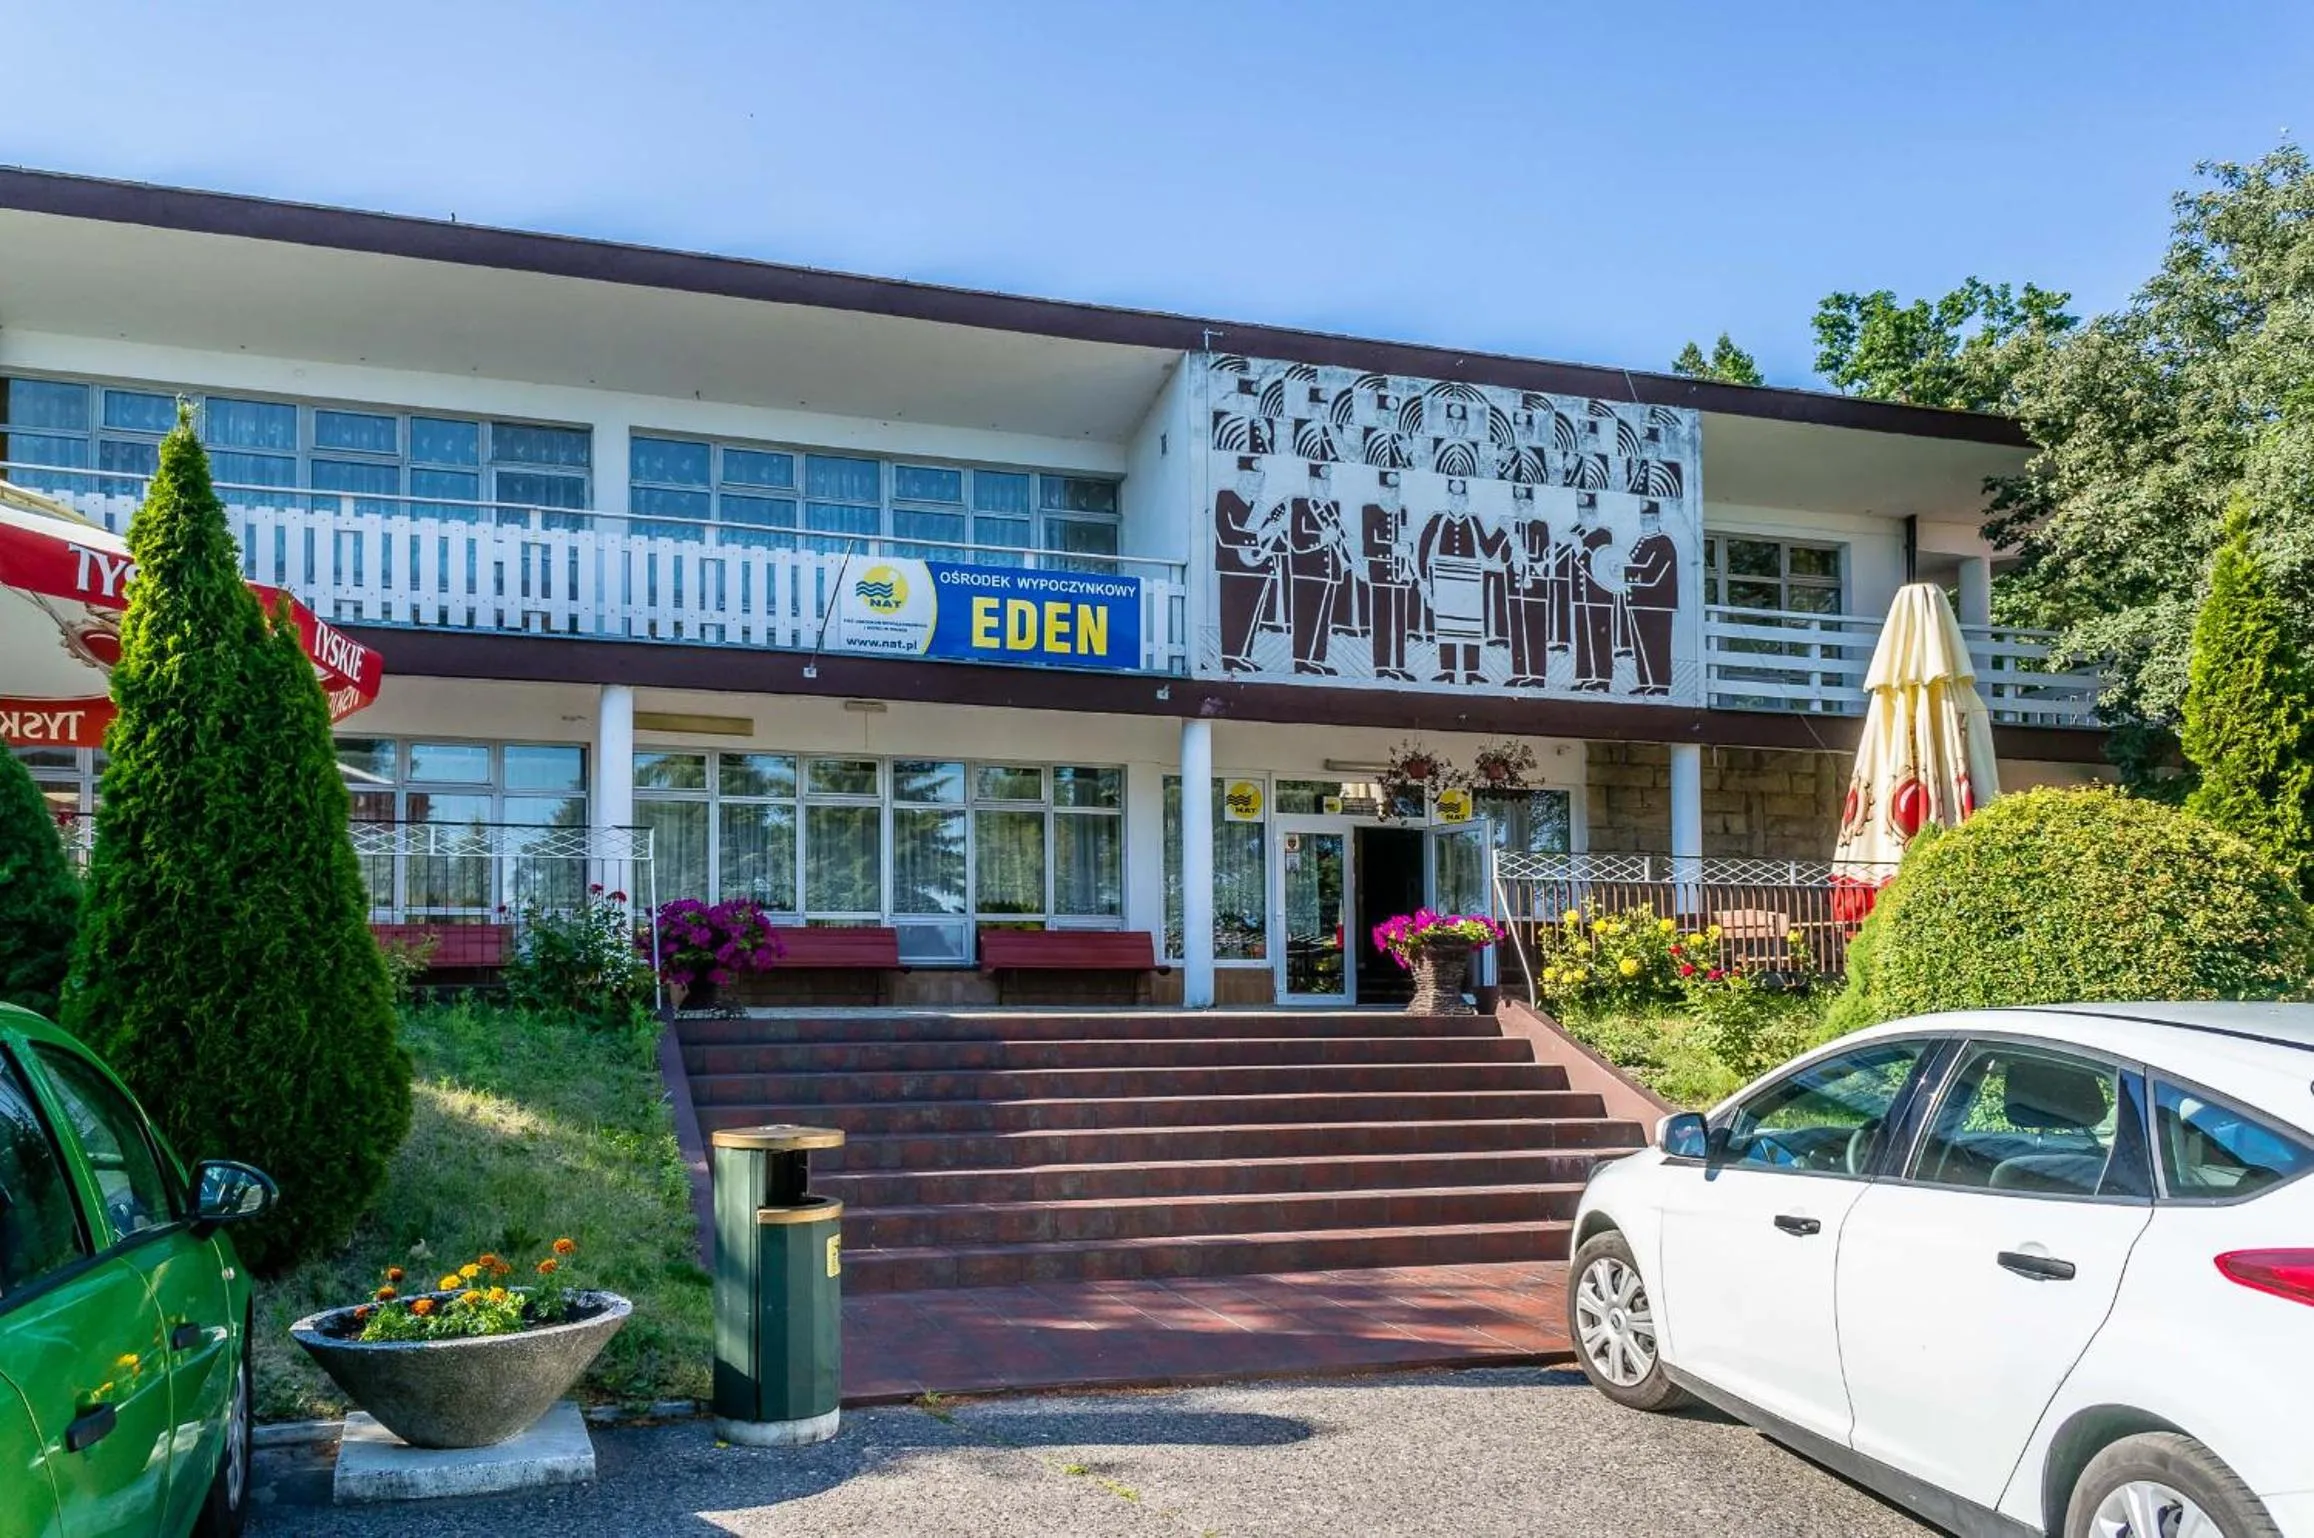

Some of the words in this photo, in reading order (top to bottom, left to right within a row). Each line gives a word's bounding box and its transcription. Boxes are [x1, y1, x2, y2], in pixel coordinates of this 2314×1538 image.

[939, 570, 1011, 588] OŚRODEK
[1017, 577, 1137, 598] WYPOCZYNKOWY
[869, 598, 902, 608] NAT
[972, 596, 1108, 656] EDEN
[314, 616, 366, 683] TYSKIE
[846, 637, 917, 650] www.nat.pl
